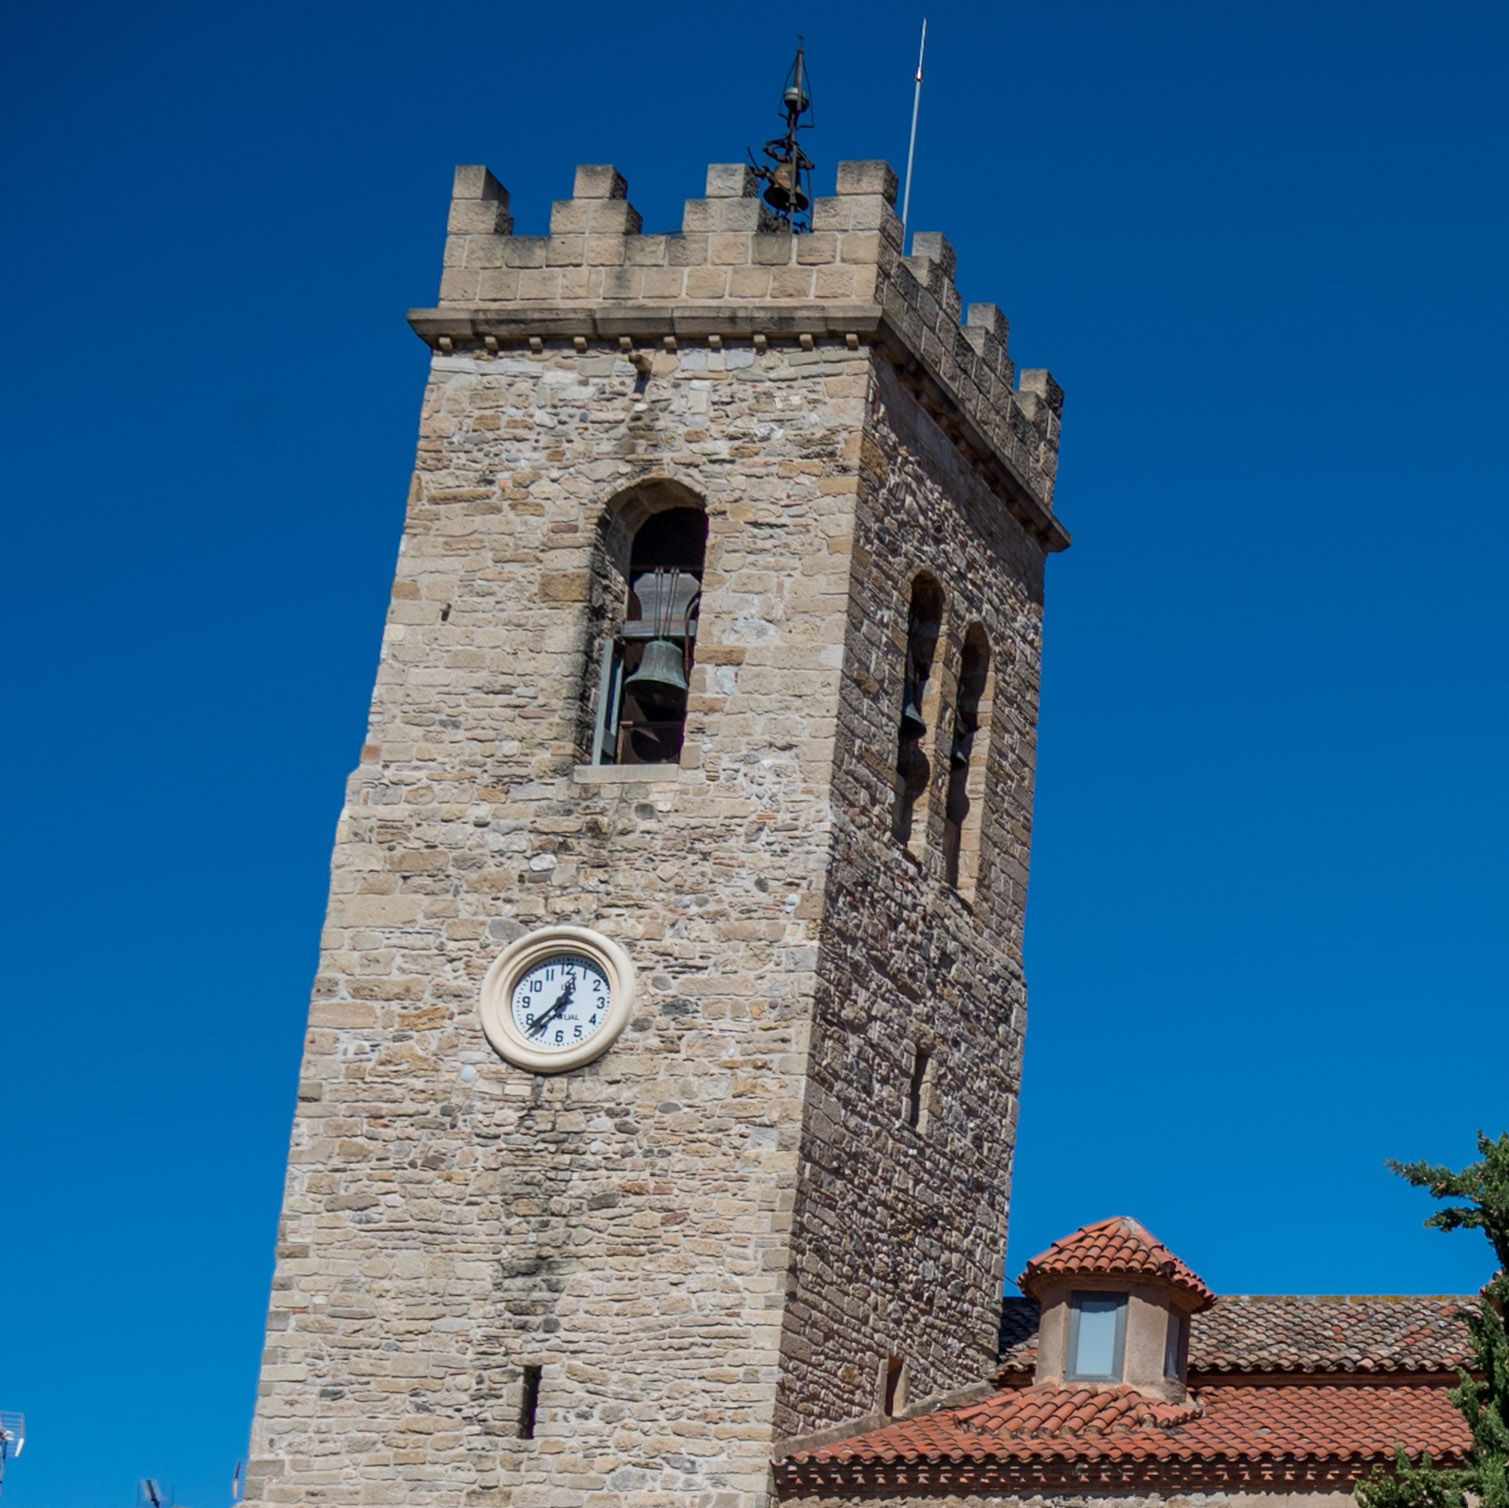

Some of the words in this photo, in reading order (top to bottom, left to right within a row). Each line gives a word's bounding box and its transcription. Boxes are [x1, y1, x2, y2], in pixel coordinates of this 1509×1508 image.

[546, 969, 554, 981] 11
[561, 963, 576, 975] 12
[583, 967, 588, 980] 1
[529, 979, 542, 992] 10
[593, 979, 602, 992] 2
[522, 996, 531, 1009] 9
[597, 996, 605, 1009] 3
[526, 1013, 535, 1026] 8
[589, 1013, 597, 1026] 4
[555, 1030, 564, 1043] 6
[573, 1025, 583, 1038] 5
